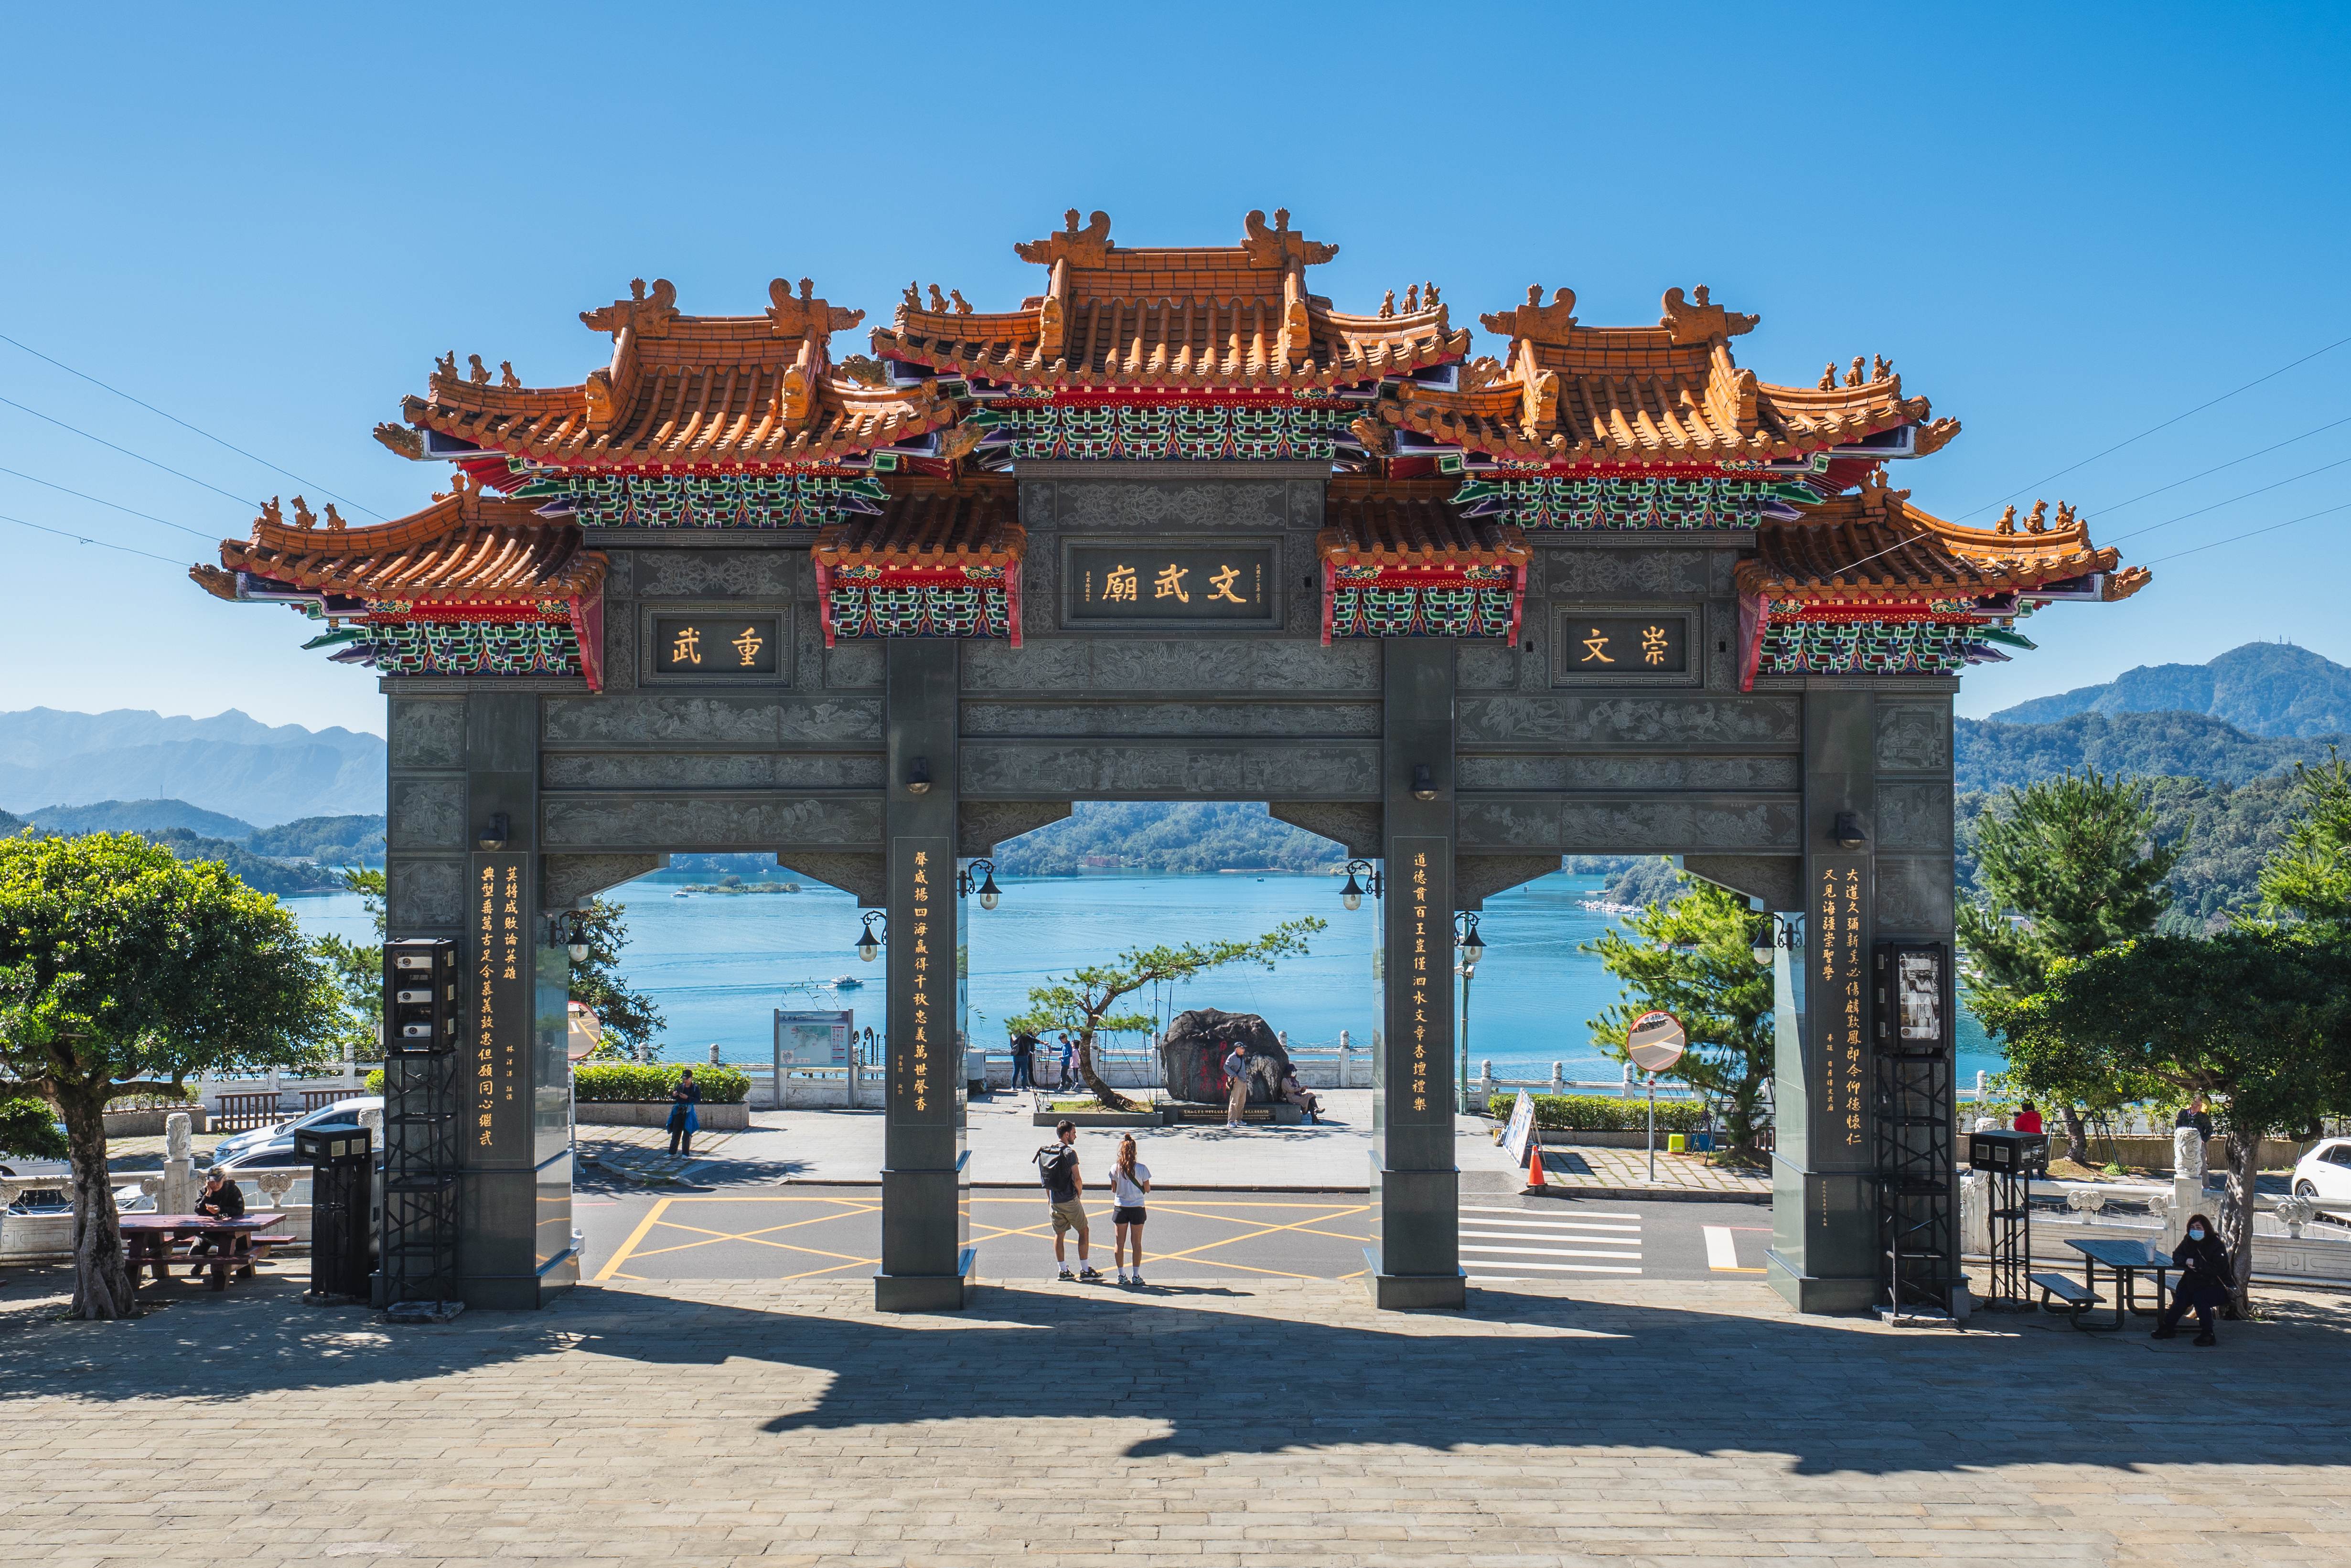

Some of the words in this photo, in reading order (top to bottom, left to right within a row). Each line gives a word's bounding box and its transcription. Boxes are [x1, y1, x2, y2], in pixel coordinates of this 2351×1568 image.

[1102, 564, 1247, 603] 文武廟
[672, 627, 763, 666] 重武
[1581, 626, 1669, 665] 崇文
[503, 866, 519, 979] 莫將成敗論英雄
[1823, 869, 1837, 981] 又見海疆崇聖學
[1412, 853, 1428, 1111] 道德貫百王豈僅泗水文章杏壇禮樂
[1649, 1088, 1654, 1100] 注意
